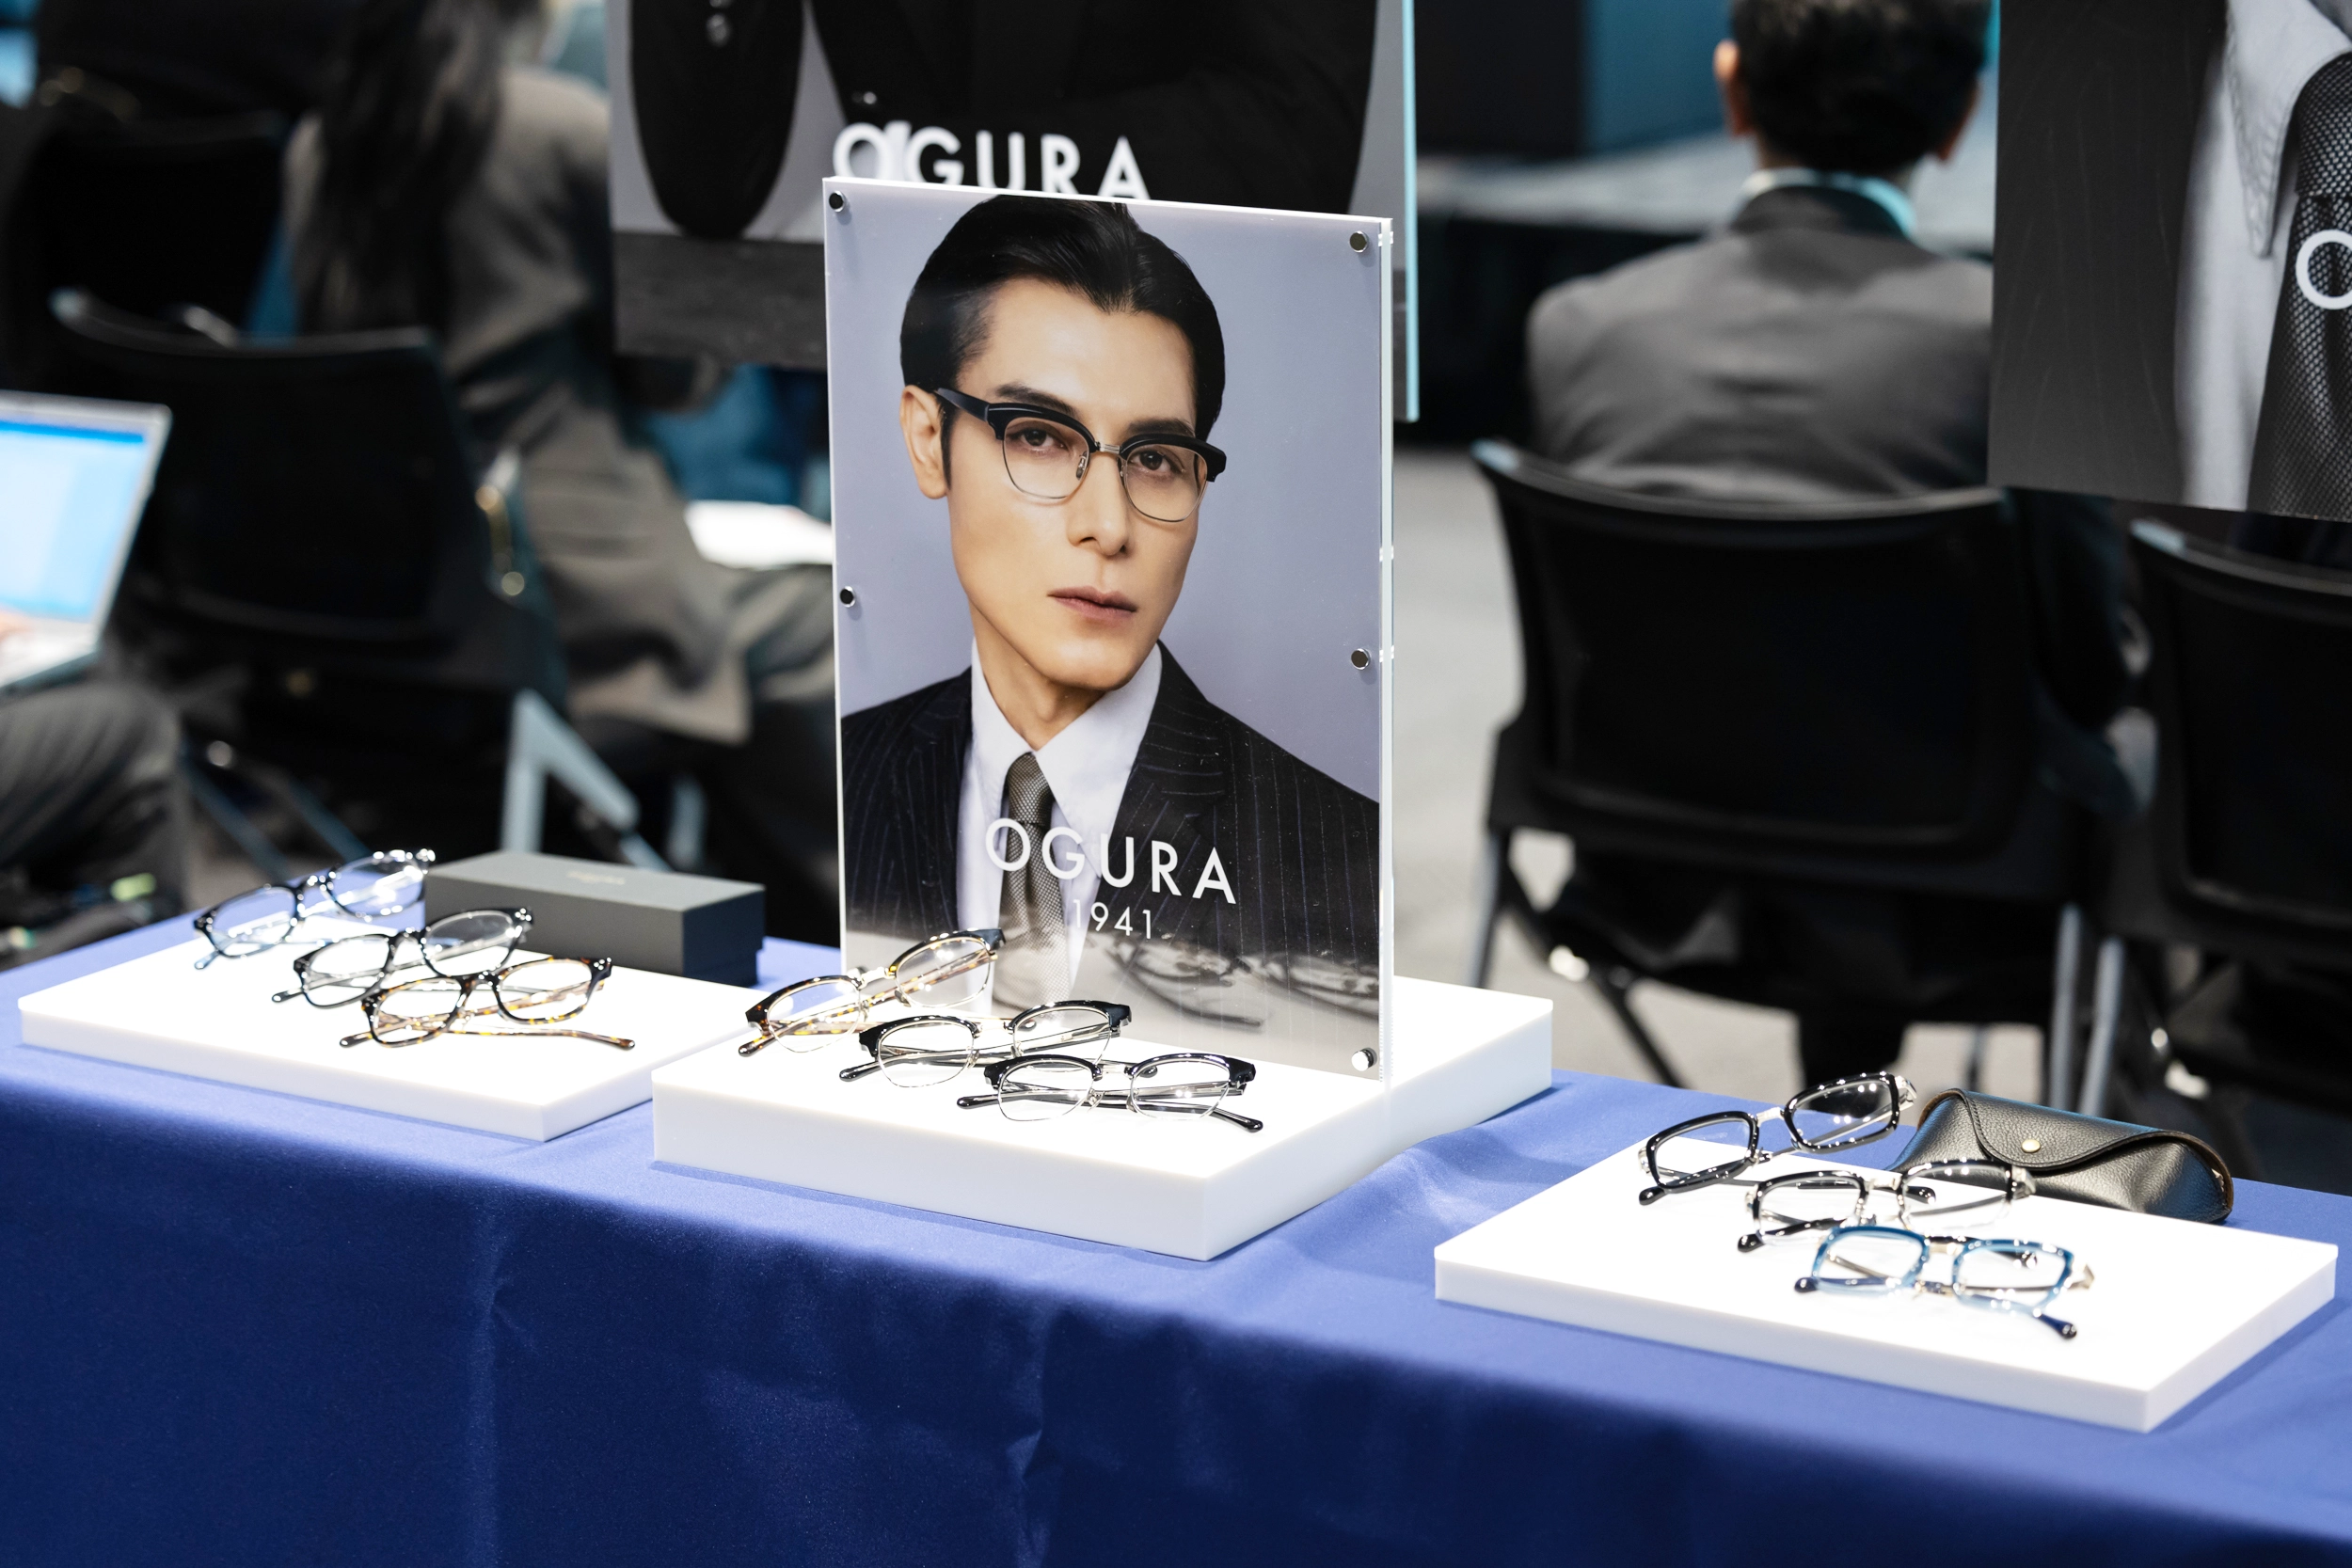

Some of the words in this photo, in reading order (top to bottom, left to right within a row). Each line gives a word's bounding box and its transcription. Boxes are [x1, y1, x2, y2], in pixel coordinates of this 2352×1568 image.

[833, 121, 1151, 199] OGURA
[985, 817, 1237, 905] OGURA
[1073, 898, 1152, 940] 1941
